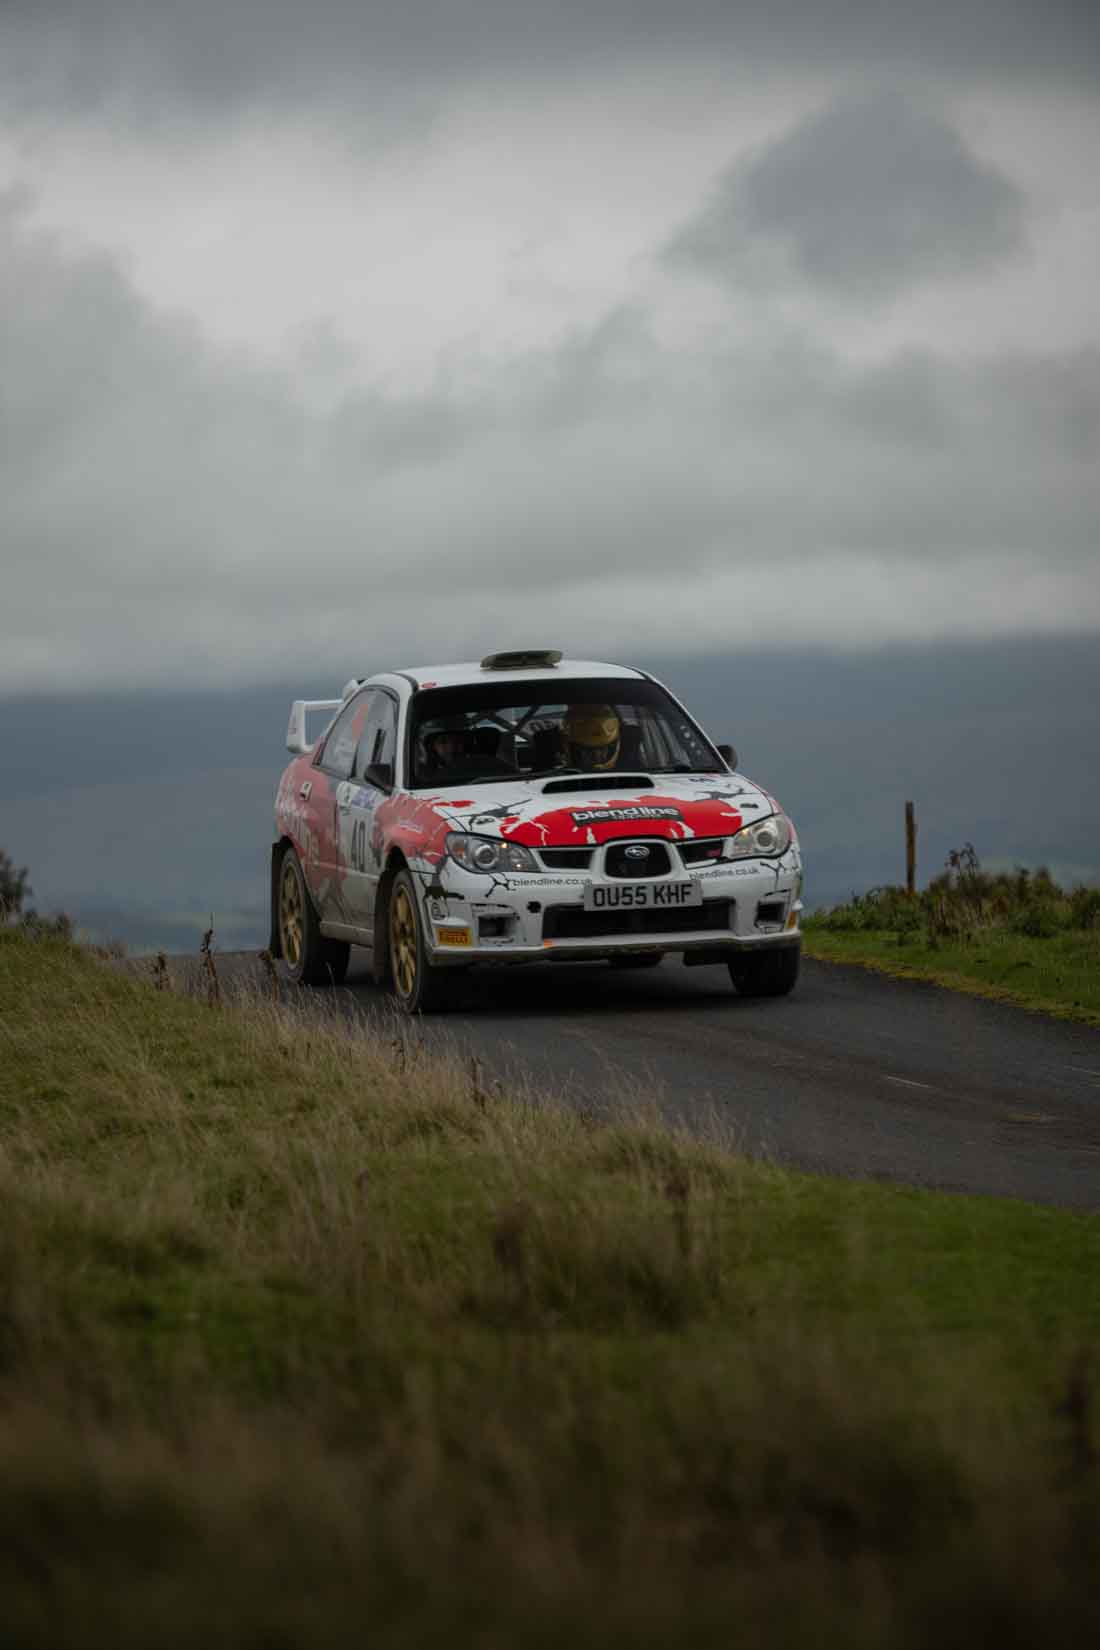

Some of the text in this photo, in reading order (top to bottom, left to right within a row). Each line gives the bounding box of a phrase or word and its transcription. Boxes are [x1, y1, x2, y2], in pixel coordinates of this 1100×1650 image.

[572, 807, 680, 821] blendline
[592, 883, 693, 907] OU55 KHF
